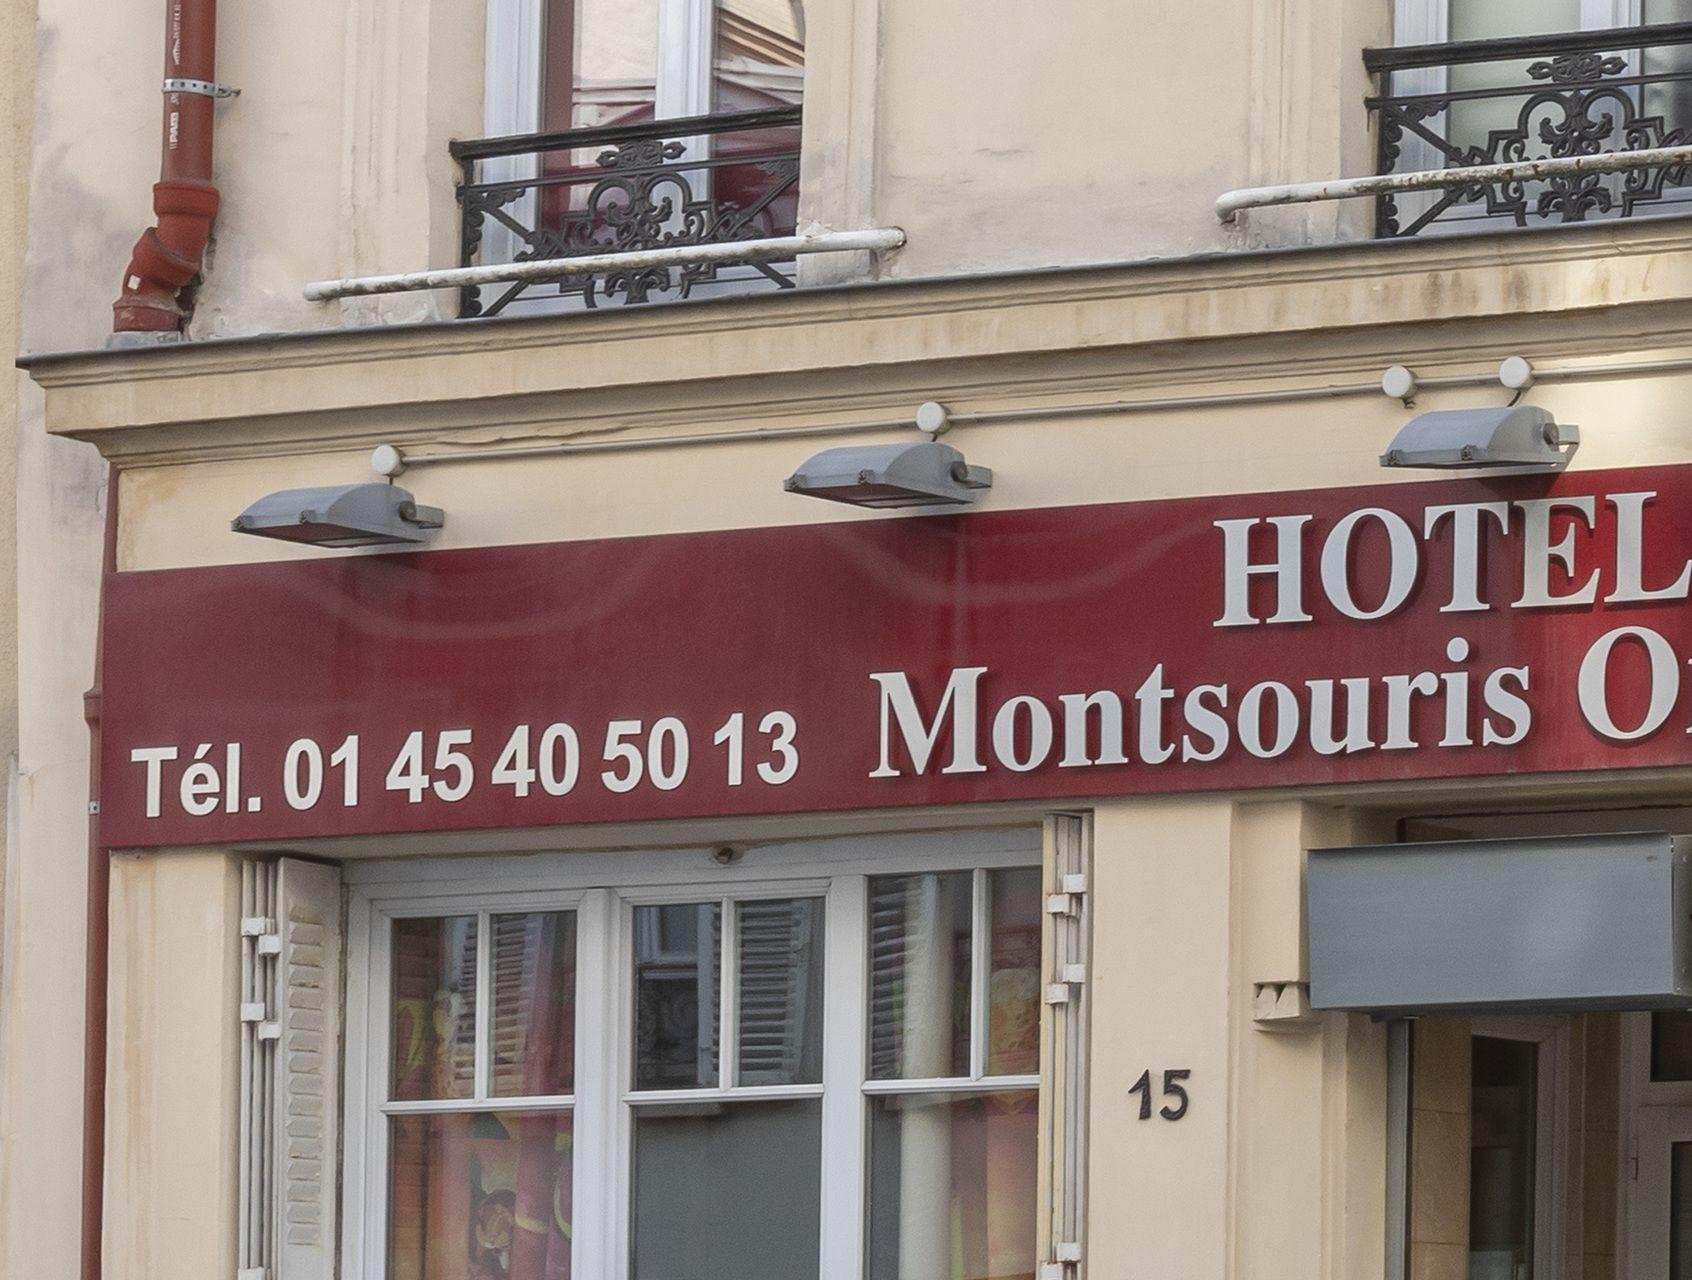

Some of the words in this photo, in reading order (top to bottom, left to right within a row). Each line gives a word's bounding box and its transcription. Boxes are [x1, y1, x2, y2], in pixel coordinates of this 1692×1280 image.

[868, 636, 1532, 779] Montsouris
[130, 744, 262, 818] Tél.
[282, 734, 361, 811] 01
[384, 728, 475, 804] 45
[490, 722, 580, 798] 40
[600, 716, 690, 794] 50
[712, 710, 800, 787] 13
[1127, 1068, 1191, 1122] 15
